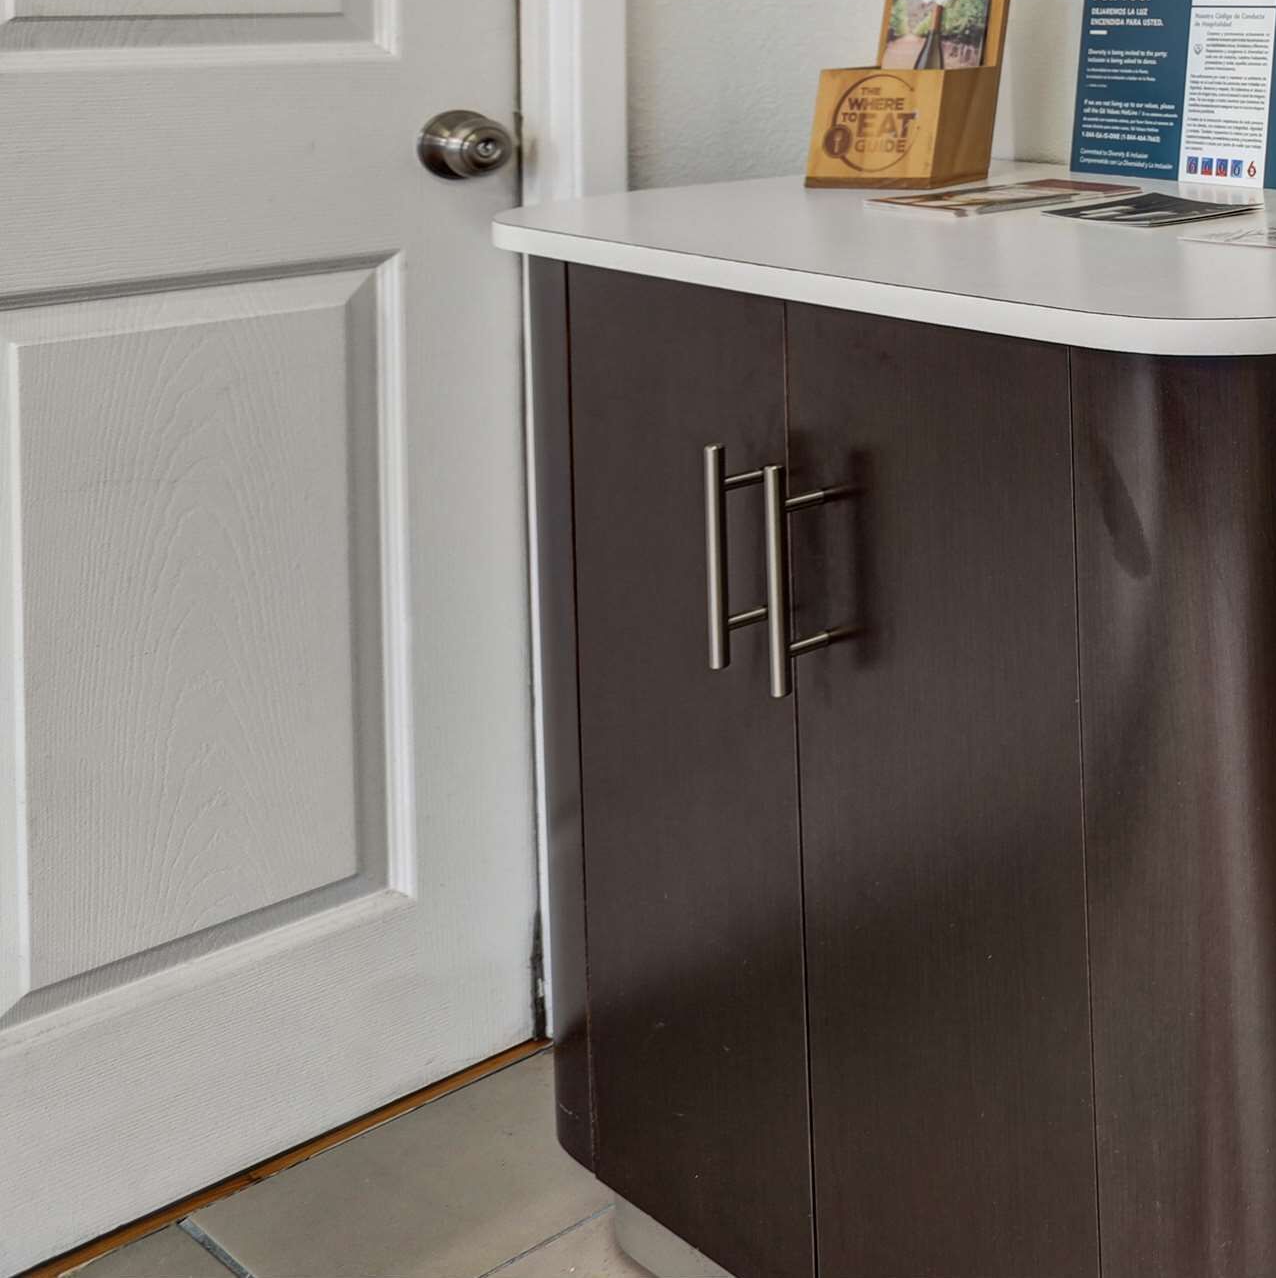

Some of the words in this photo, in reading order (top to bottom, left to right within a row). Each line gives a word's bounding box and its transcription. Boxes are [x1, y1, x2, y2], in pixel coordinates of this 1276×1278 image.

[1136, 8, 1148, 16] LUZ
[1125, 18, 1141, 26] PARA
[861, 87, 881, 96] THE
[848, 97, 904, 111] WHERE
[842, 112, 857, 123] TO
[857, 112, 916, 139] EAT
[854, 139, 907, 153] GUIDE
[1247, 160, 1257, 178] 6
